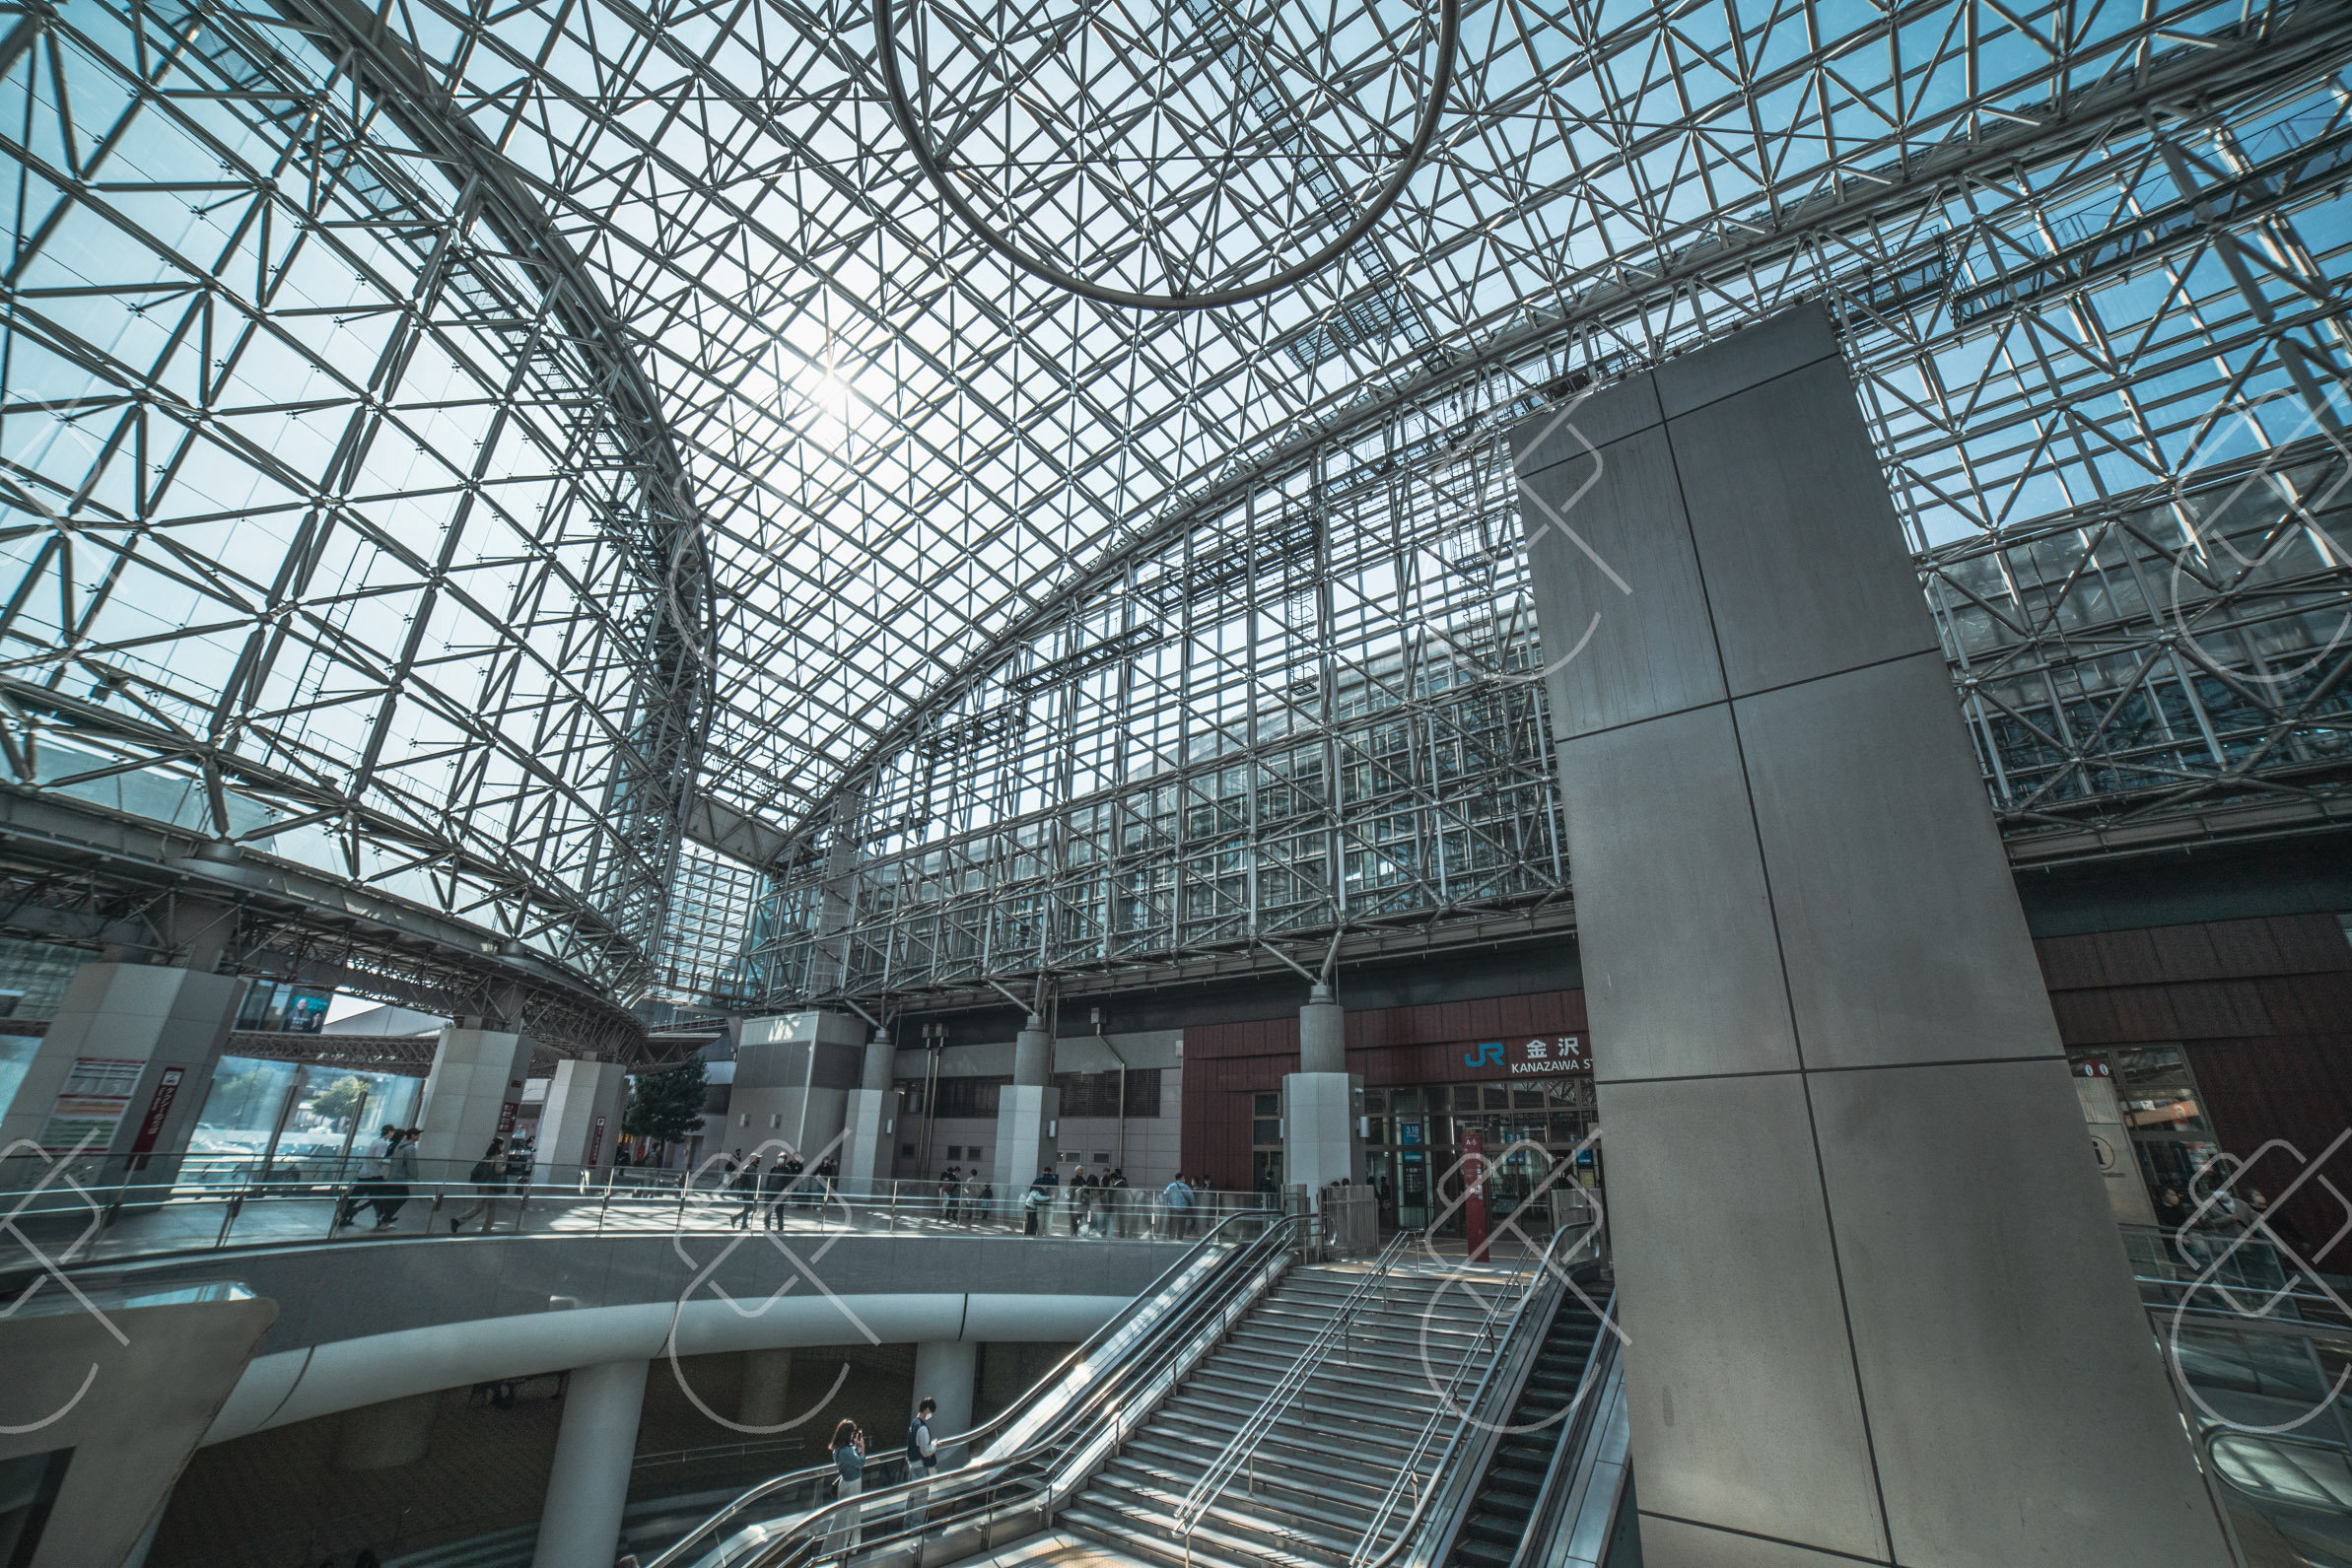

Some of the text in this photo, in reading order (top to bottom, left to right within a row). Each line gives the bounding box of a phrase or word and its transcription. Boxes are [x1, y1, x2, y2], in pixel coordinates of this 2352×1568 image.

[1465, 1043, 1506, 1067] JR
[1526, 1037, 1580, 1059] 金沢
[1511, 1059, 1579, 1074] KANAZAWA
